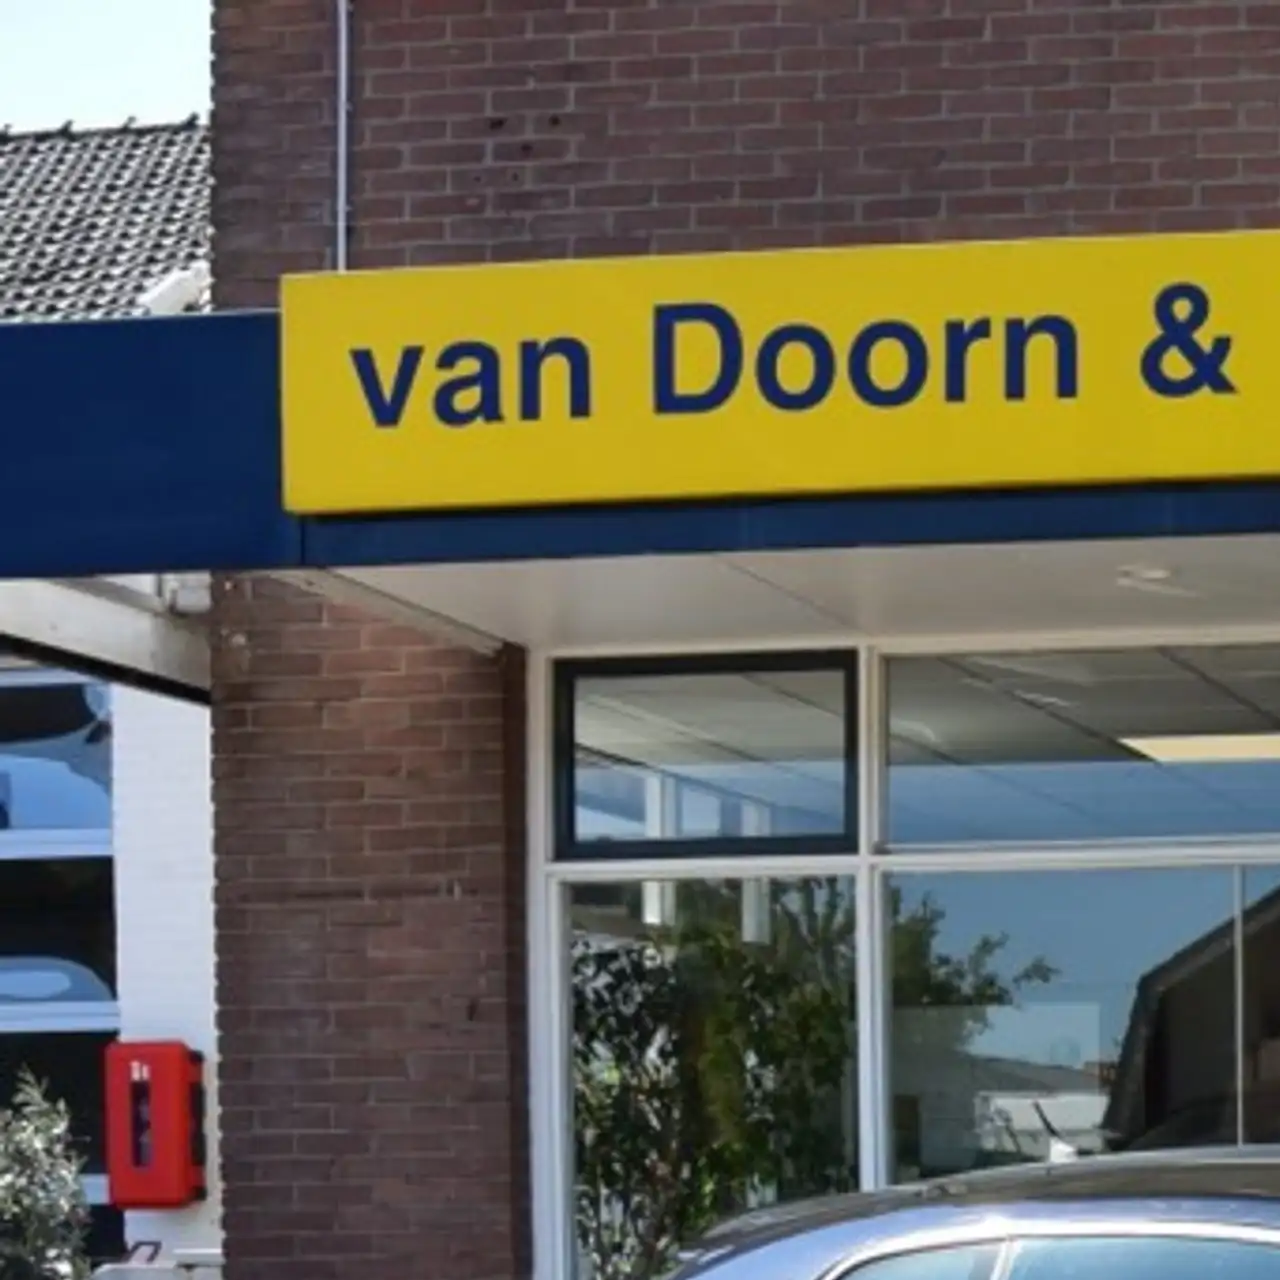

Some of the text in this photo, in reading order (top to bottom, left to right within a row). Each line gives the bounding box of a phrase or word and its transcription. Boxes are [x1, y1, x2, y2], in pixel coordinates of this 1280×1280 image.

[349, 335, 592, 429] van
[652, 302, 1079, 415] Doorn
[1140, 281, 1240, 398] &
